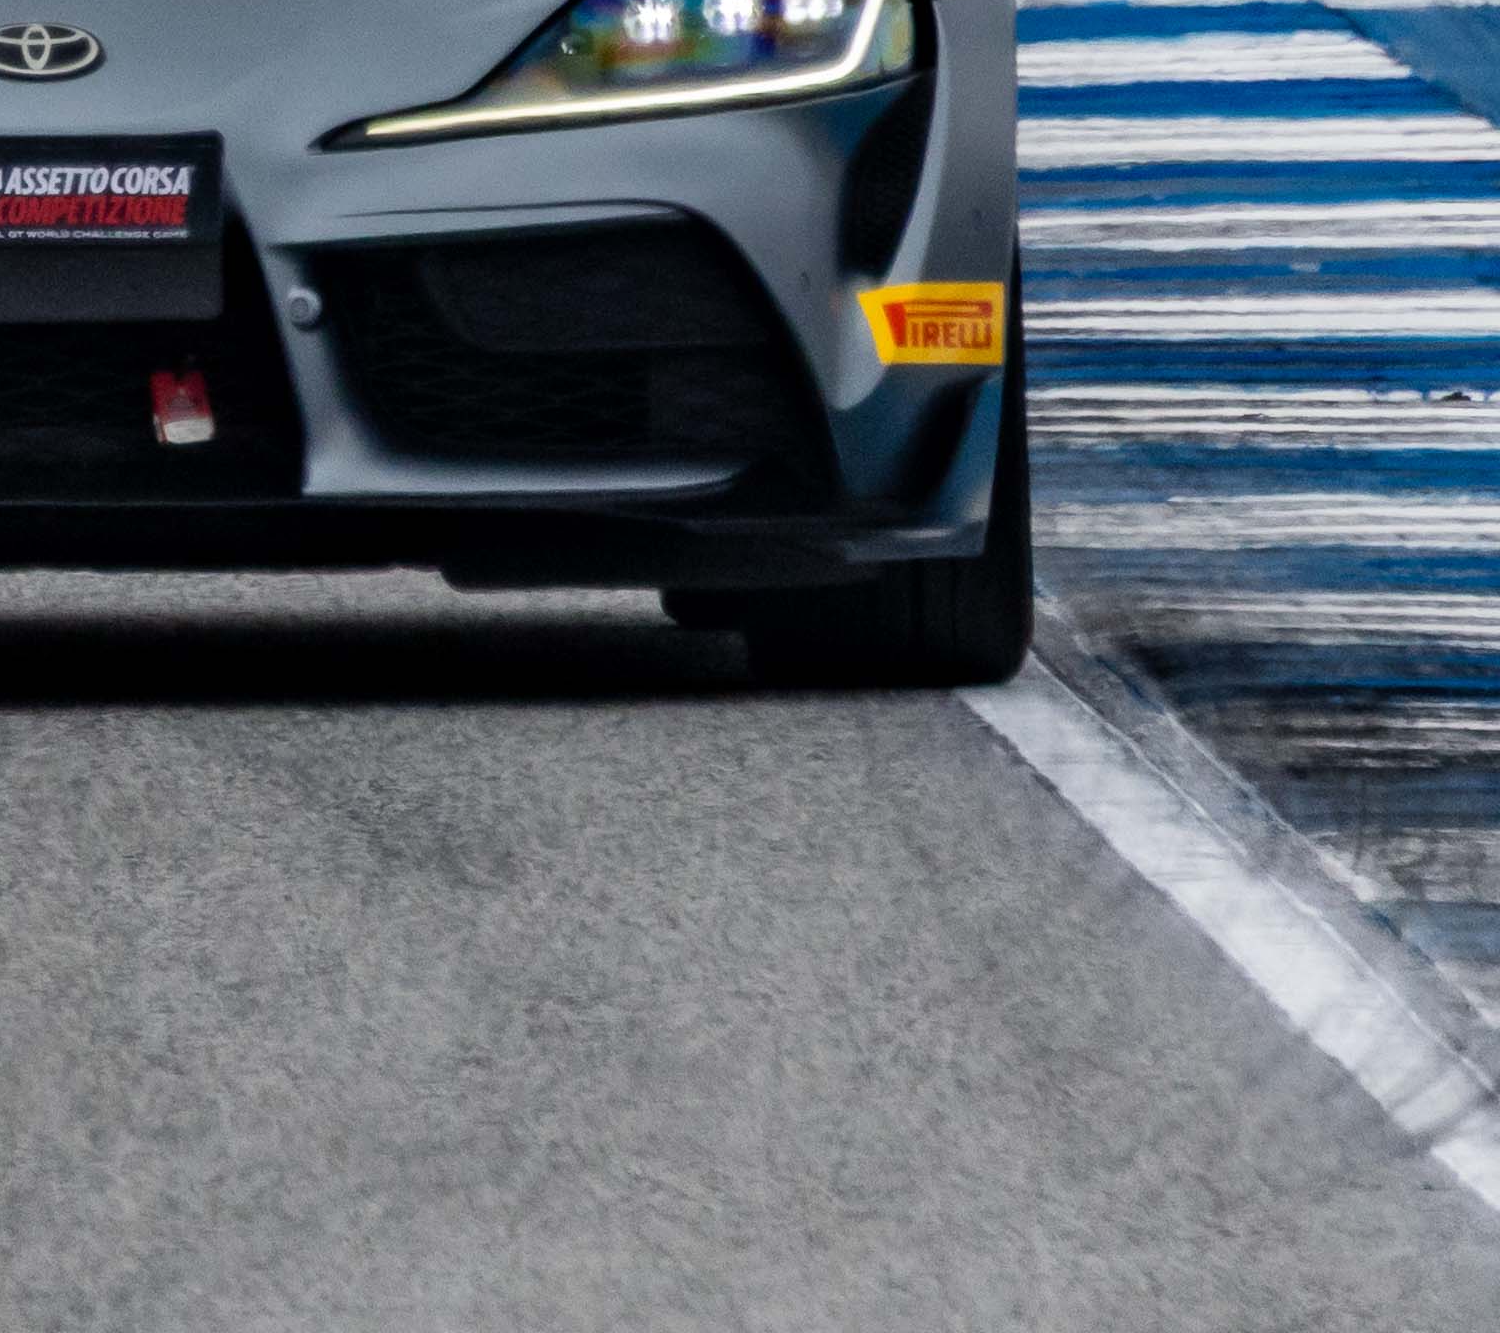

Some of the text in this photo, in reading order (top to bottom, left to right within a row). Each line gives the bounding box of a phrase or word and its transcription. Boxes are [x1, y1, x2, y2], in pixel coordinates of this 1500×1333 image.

[3, 166, 190, 195] ASSETTO CORSA
[8, 229, 24, 239] GT
[26, 229, 71, 239] WORLD
[73, 229, 150, 239] CHALLENGE
[882, 299, 993, 349] PIRELLI
